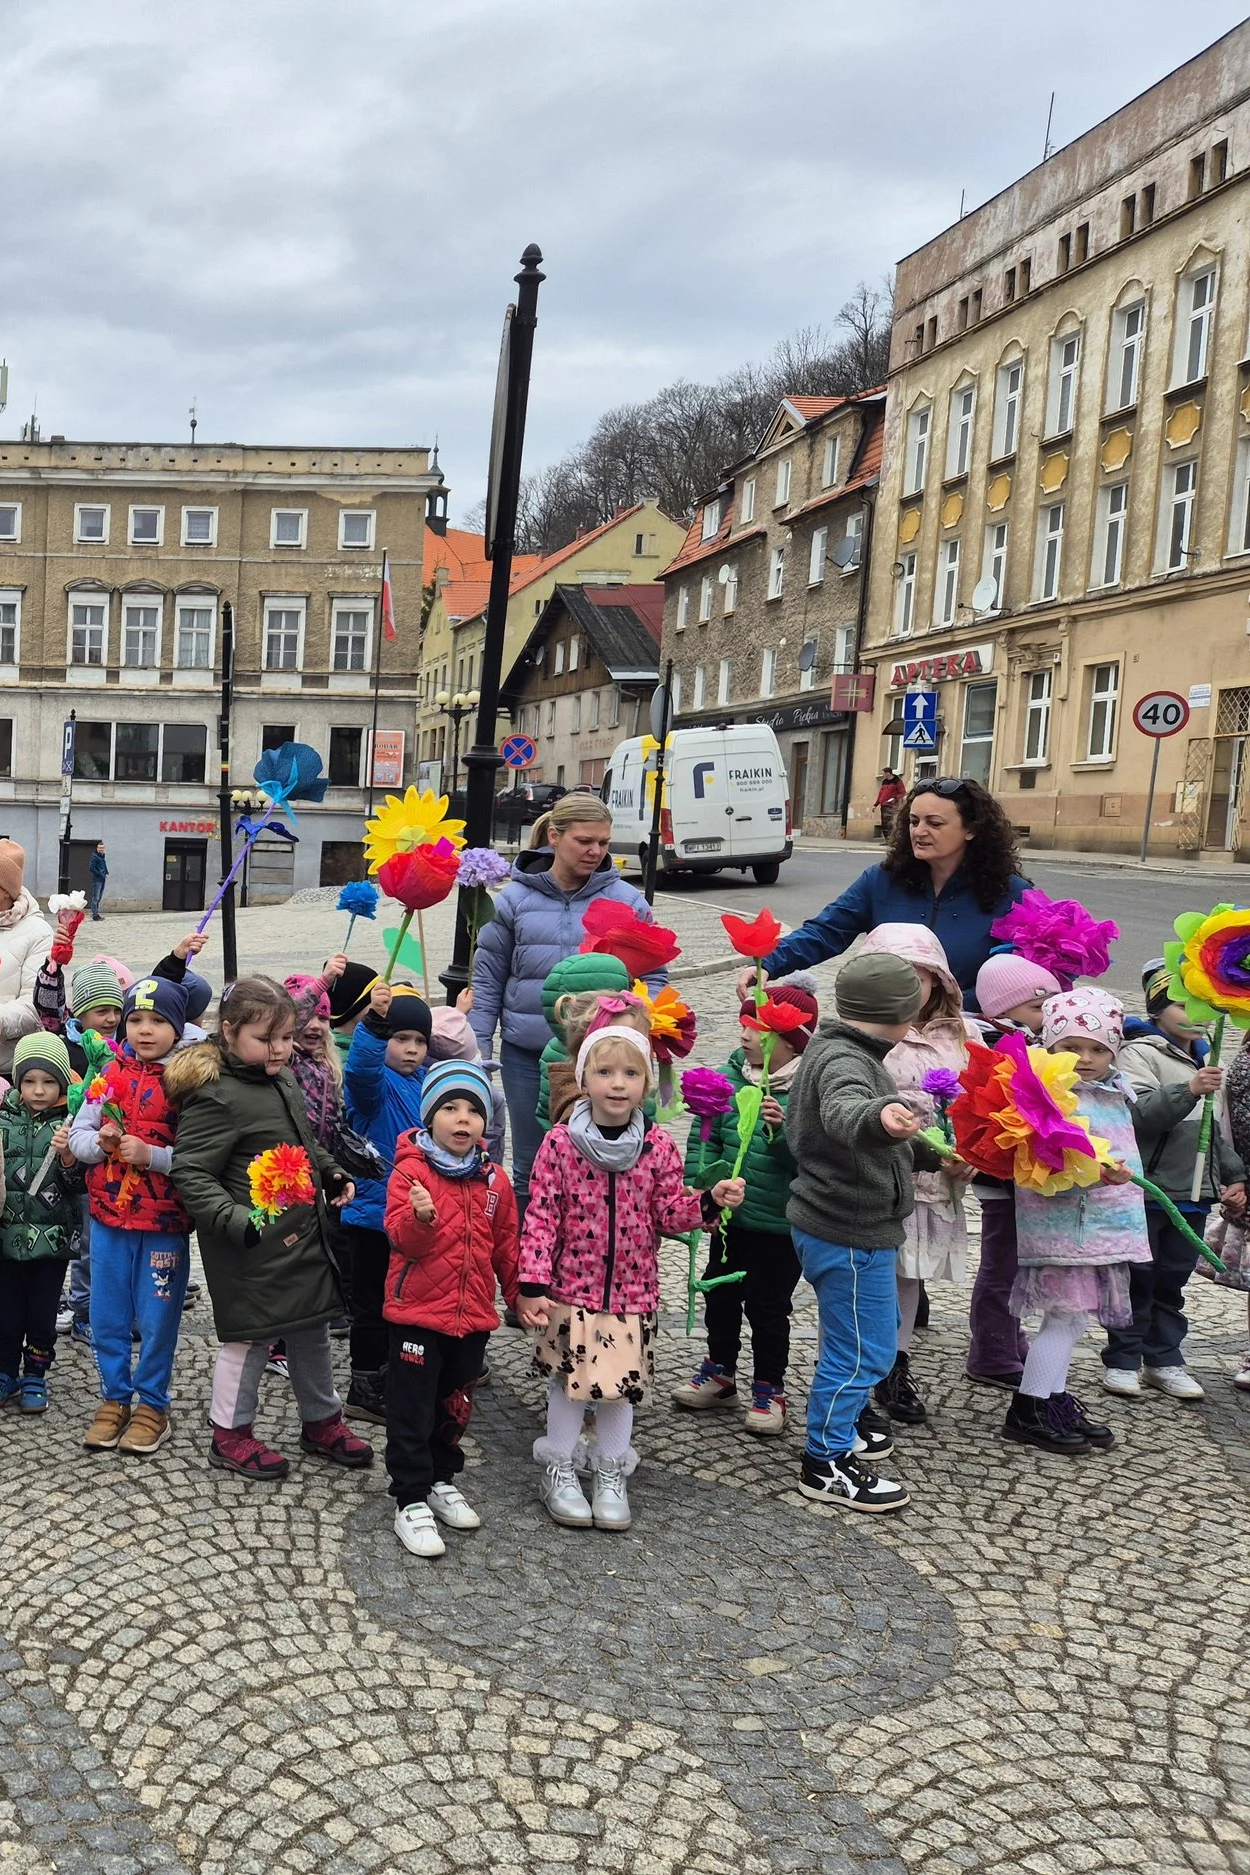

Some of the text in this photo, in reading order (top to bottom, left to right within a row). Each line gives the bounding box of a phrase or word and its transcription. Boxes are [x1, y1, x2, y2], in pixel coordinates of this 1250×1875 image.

[891, 651, 982, 685] APTEKA
[1141, 703, 1181, 725] 40
[729, 767, 772, 780] FRAIKIN
[612, 789, 634, 808] FRAIKIN
[159, 821, 214, 832] KANTOR
[402, 1341, 425, 1356] HERO
[399, 1351, 426, 1366] POWER
